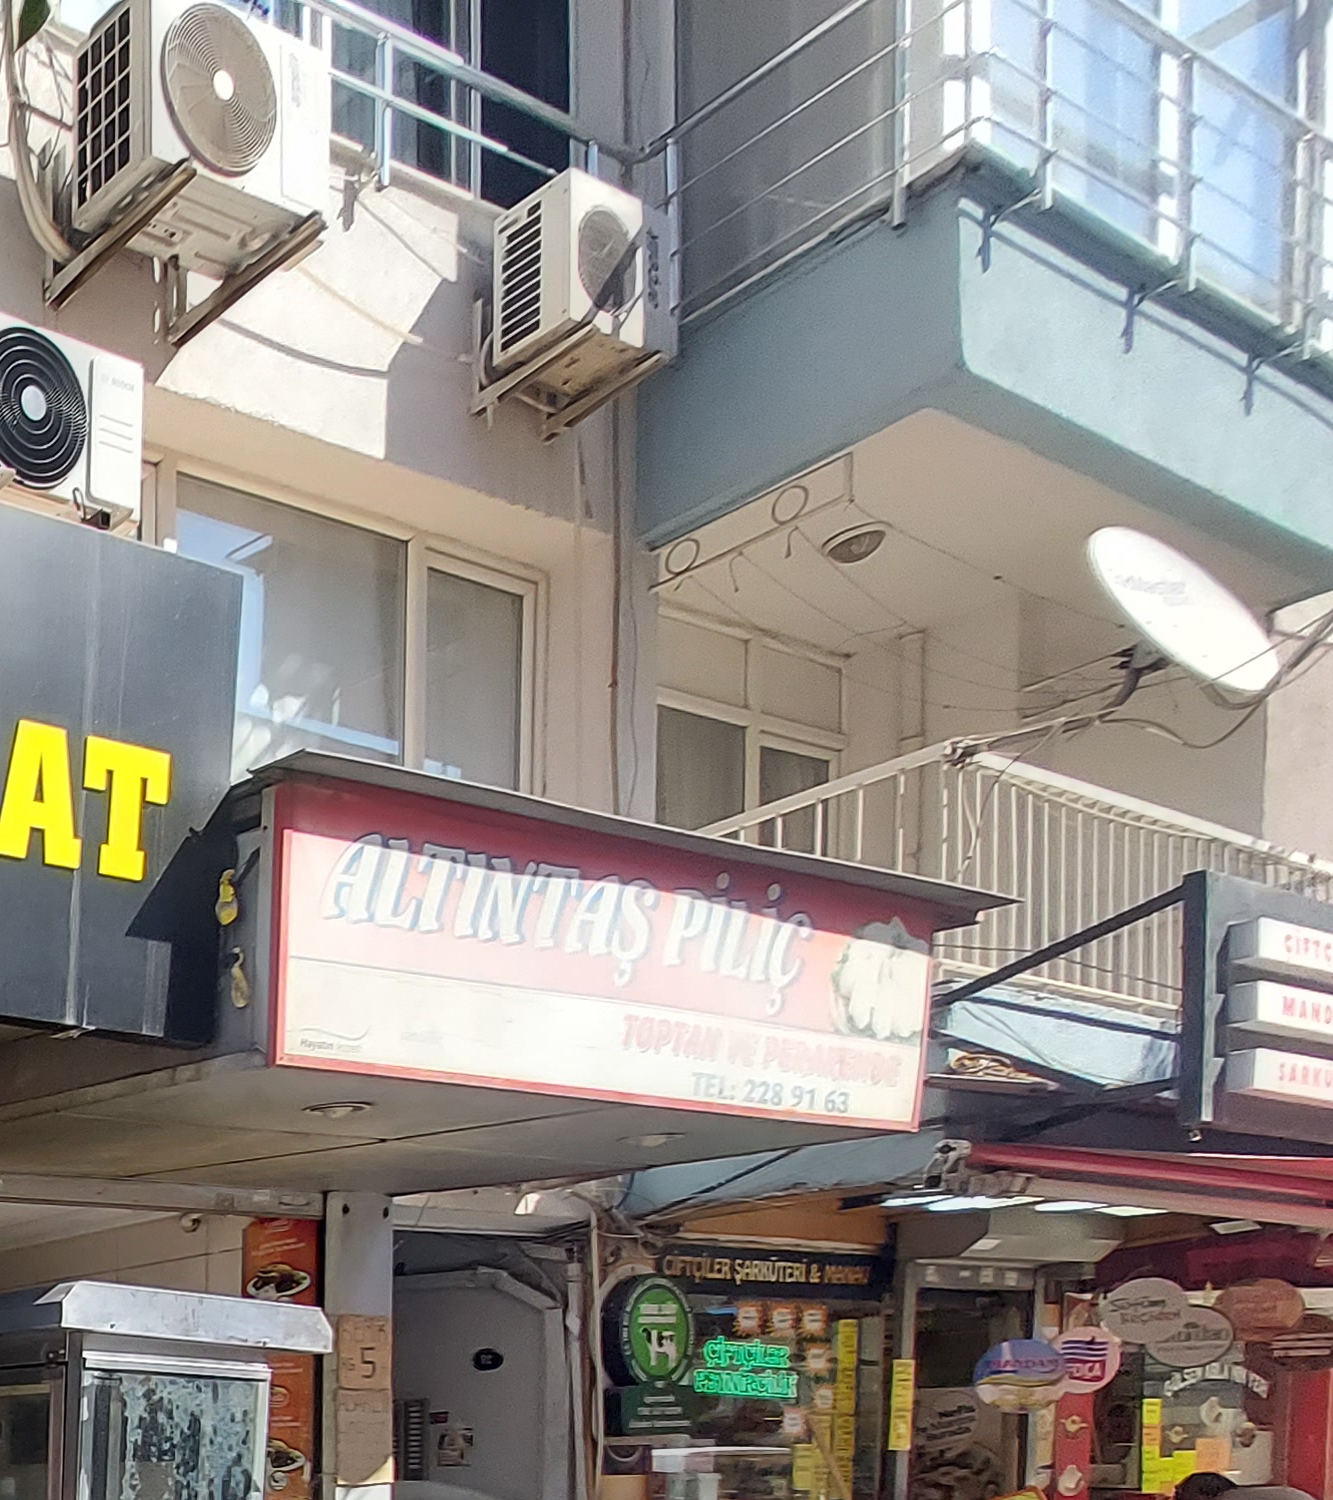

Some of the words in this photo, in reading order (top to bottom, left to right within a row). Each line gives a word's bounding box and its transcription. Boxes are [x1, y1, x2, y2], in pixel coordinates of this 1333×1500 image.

[320, 832, 660, 987] ALTINTAŞ
[663, 871, 814, 1016] PİLİÇ
[691, 1071, 735, 1101] TEL:
[742, 1079, 785, 1106] 228
[791, 1085, 816, 1111] 91
[824, 1090, 850, 1114] 63
[809, 1263, 822, 1284] &
